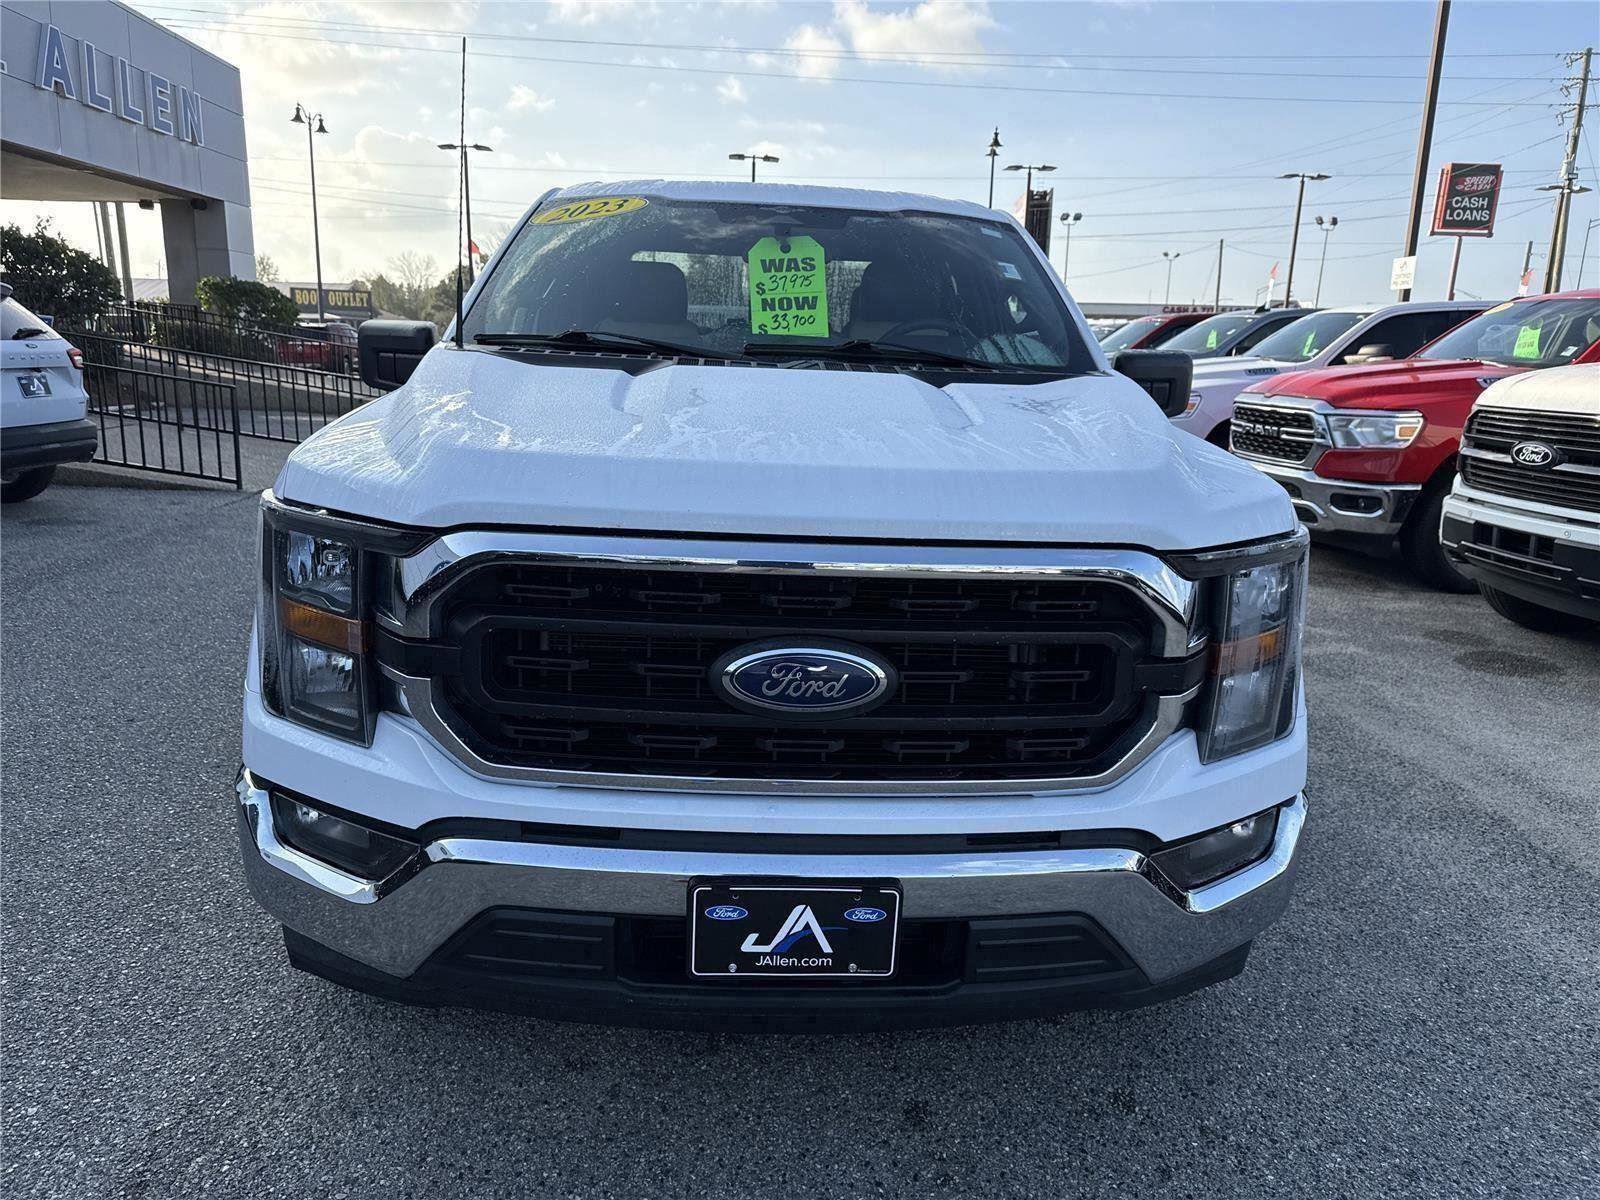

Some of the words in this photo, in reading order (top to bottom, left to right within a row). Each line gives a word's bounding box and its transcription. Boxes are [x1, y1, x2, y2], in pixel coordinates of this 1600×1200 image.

[39, 23, 204, 147] ALLEN
[1464, 175, 1496, 186] SPEEDY
[546, 199, 630, 222] 2023
[1452, 196, 1488, 209] CASH
[1445, 209, 1490, 221] LOANS
[760, 257, 816, 273] WAS
[328, 290, 369, 307] OUTLET
[760, 295, 819, 312] NOW
[1519, 446, 1547, 463] Ford
[761, 662, 850, 699] Ford
[713, 907, 740, 919] Ford
[852, 910, 879, 921] Ford
[755, 955, 833, 967] JAllen.com
